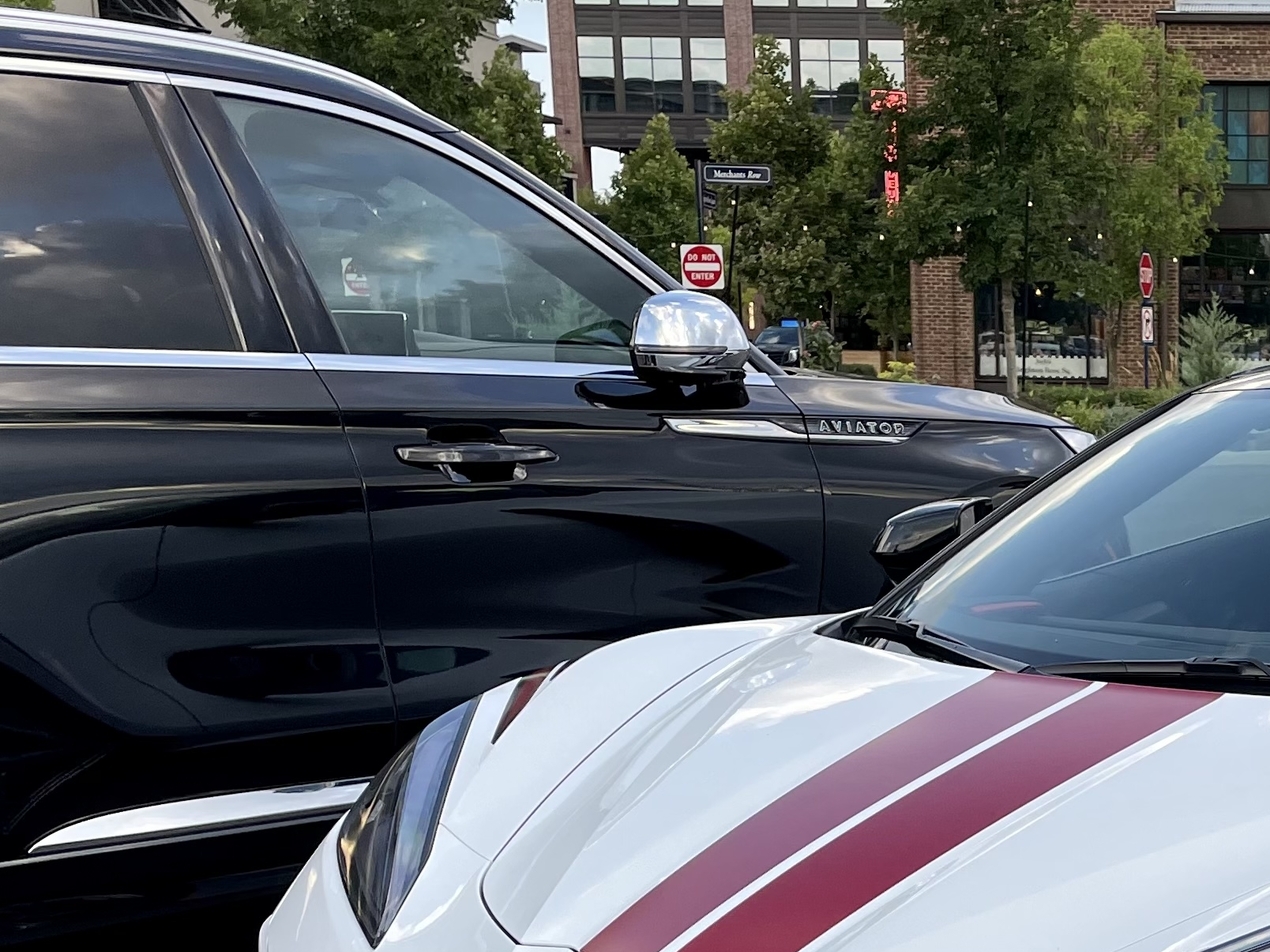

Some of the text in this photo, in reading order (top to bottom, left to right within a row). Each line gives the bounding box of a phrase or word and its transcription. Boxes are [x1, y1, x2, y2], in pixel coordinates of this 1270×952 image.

[713, 169, 762, 179] Merchants Row
[687, 253, 716, 261] DO NOT
[691, 272, 715, 280] ENTER
[819, 420, 905, 434] AVIATOR
